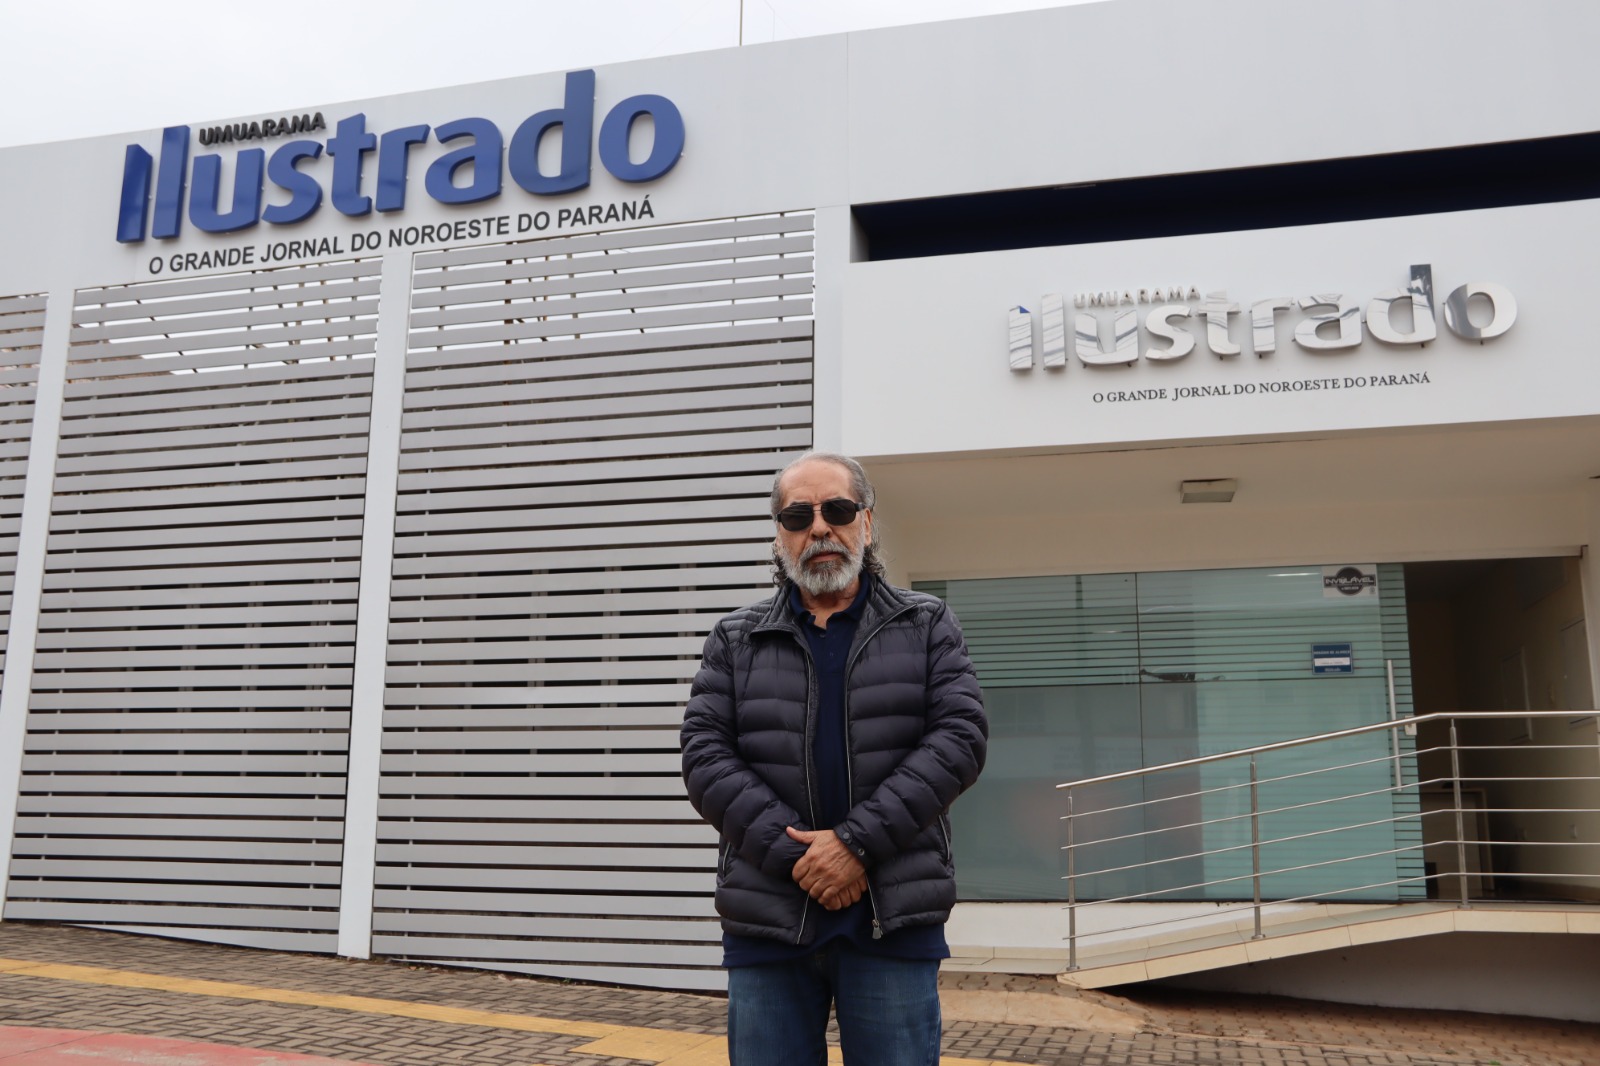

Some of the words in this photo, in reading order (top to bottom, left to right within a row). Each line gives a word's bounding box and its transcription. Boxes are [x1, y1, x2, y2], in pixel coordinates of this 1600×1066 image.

[199, 112, 326, 146] UMUARAMA
[116, 69, 686, 244] Ilustrado
[149, 256, 164, 275] O
[169, 246, 256, 272] GRANDE
[260, 236, 345, 262] JORNAL
[350, 230, 382, 252] DO
[388, 216, 511, 248] NOROESTE
[517, 210, 551, 233] DO
[557, 194, 655, 228] PARANÁ
[1073, 285, 1202, 309] UMUARAMA
[1092, 392, 1104, 404] O
[1106, 388, 1168, 402] GRANDE
[1171, 384, 1231, 401] JORNAL
[1233, 383, 1256, 395] DO
[1259, 379, 1341, 394] NOROESTE
[1344, 376, 1367, 389] DO
[1369, 371, 1431, 387] PARANÁ
